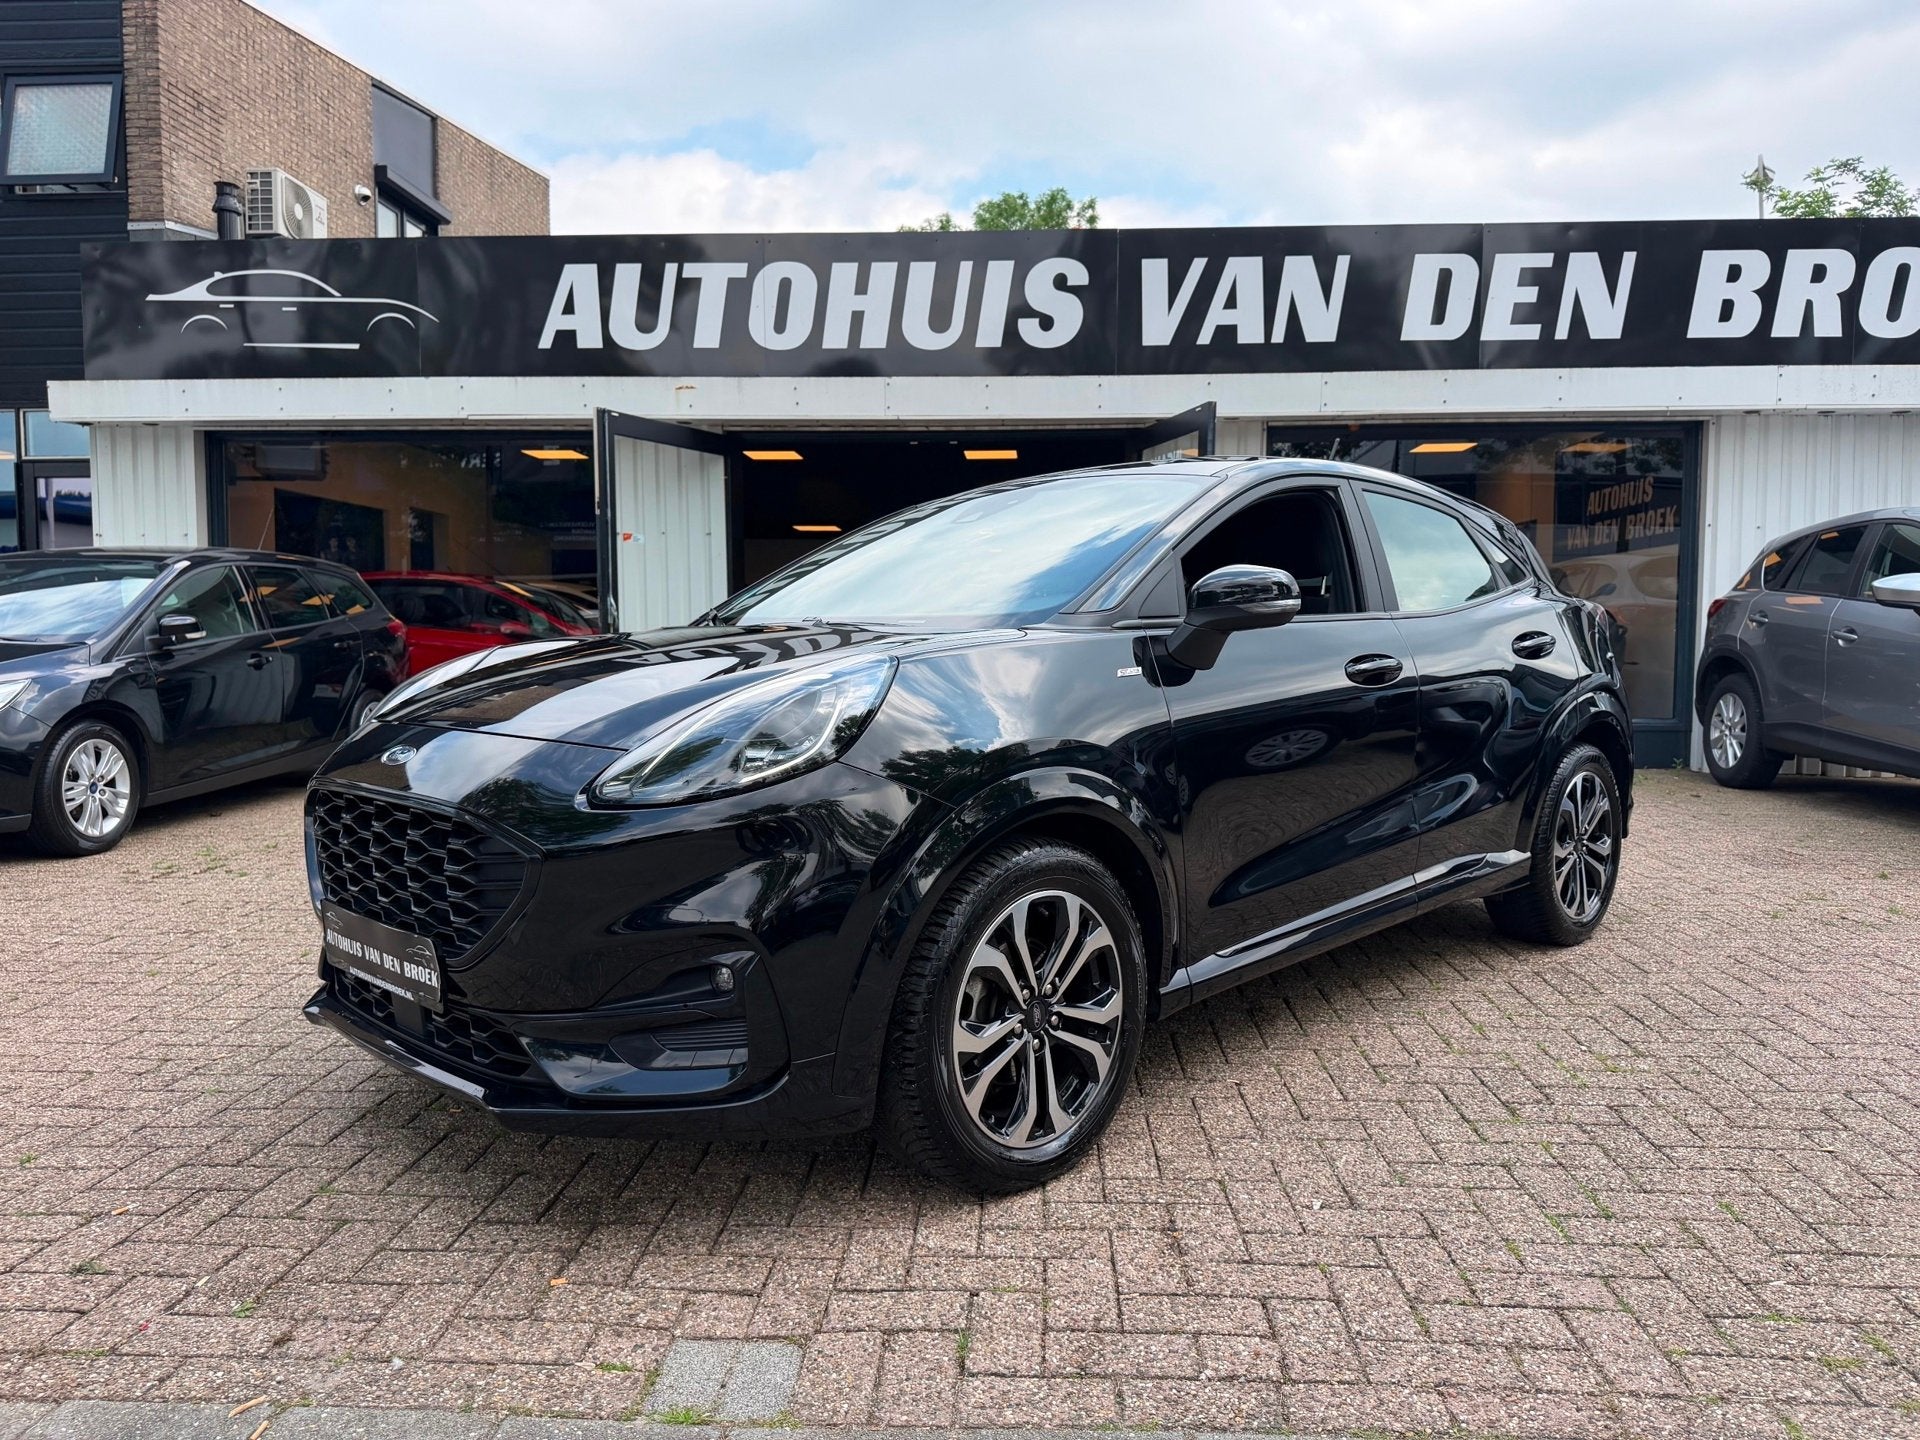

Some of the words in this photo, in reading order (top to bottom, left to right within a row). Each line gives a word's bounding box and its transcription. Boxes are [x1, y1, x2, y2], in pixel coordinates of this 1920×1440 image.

[538, 258, 1089, 351] AUTOHUIS
[1141, 255, 1350, 345] VAN
[1400, 251, 1637, 341] DEN
[1686, 246, 1920, 339] BRO
[1587, 475, 1654, 516] AUTOHUIS
[1567, 526, 1590, 550] VAN
[1594, 517, 1620, 545] DEN
[1625, 505, 1678, 540] BROEK
[326, 928, 363, 957] AUTOHUIS
[363, 944, 381, 966] VAN
[382, 952, 401, 974] DEN
[403, 961, 438, 988] BROEK
